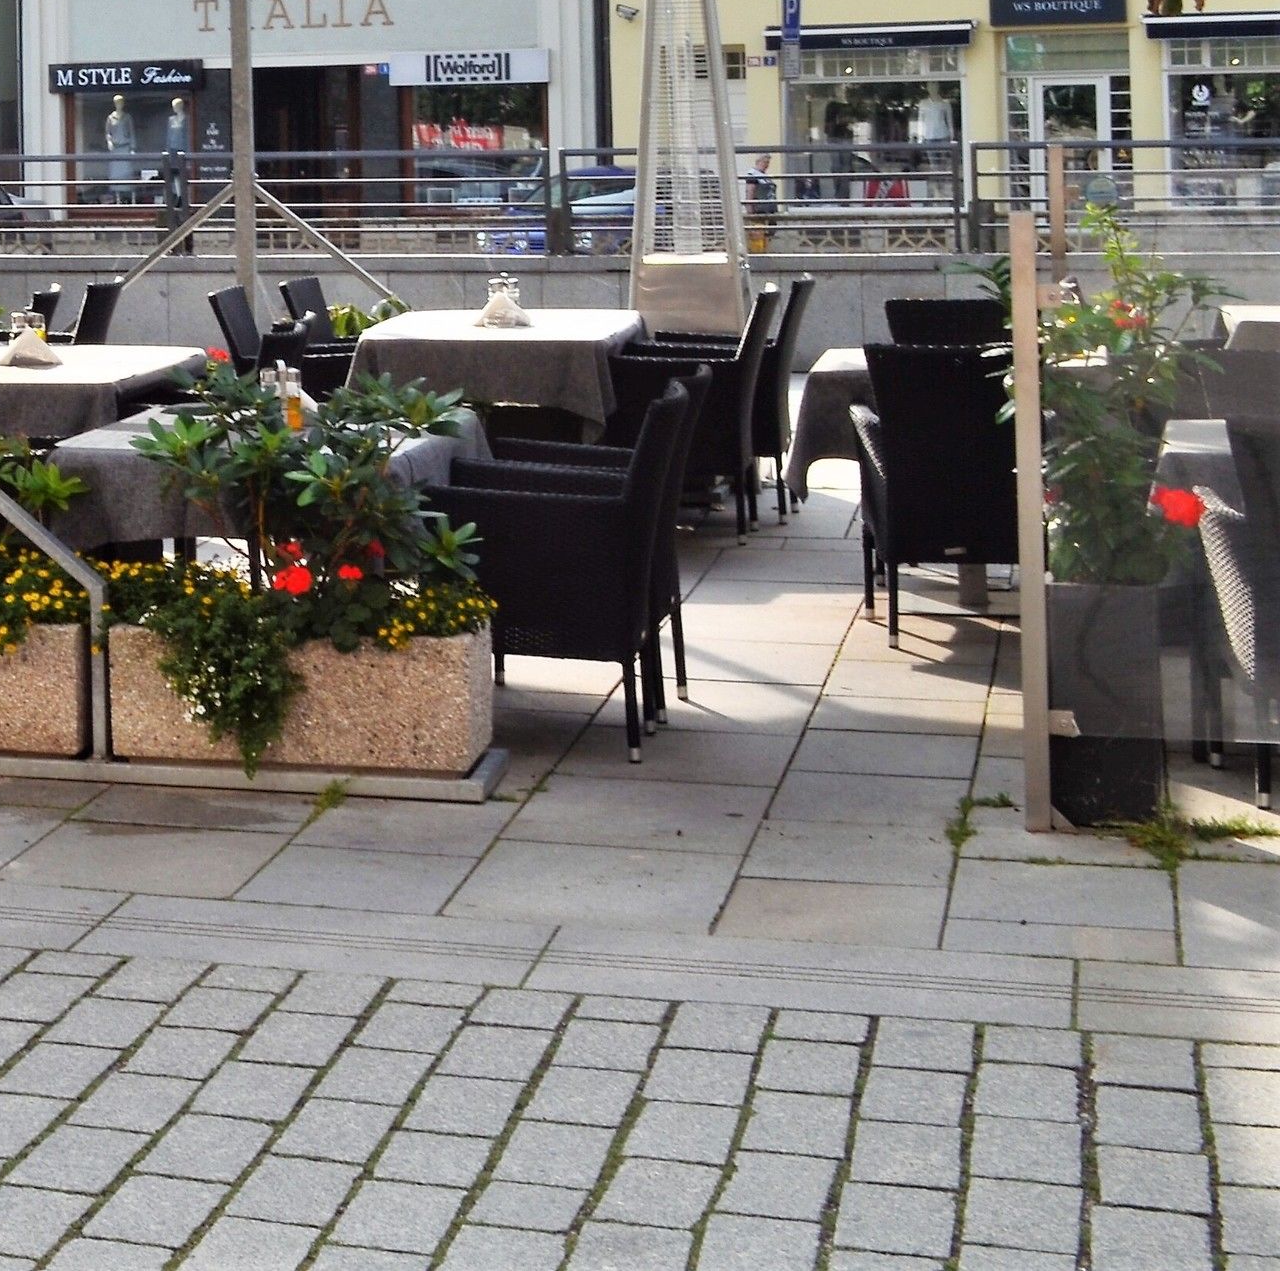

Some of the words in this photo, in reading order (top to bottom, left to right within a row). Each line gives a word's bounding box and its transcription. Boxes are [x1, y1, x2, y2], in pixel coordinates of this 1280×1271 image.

[1012, 1, 1031, 12] WS
[1034, 0, 1102, 13] BOUTIQUE
[440, 60, 496, 75] Wolford
[57, 69, 74, 87] M
[78, 67, 132, 86] STYLE
[140, 66, 192, 85] Fashion
